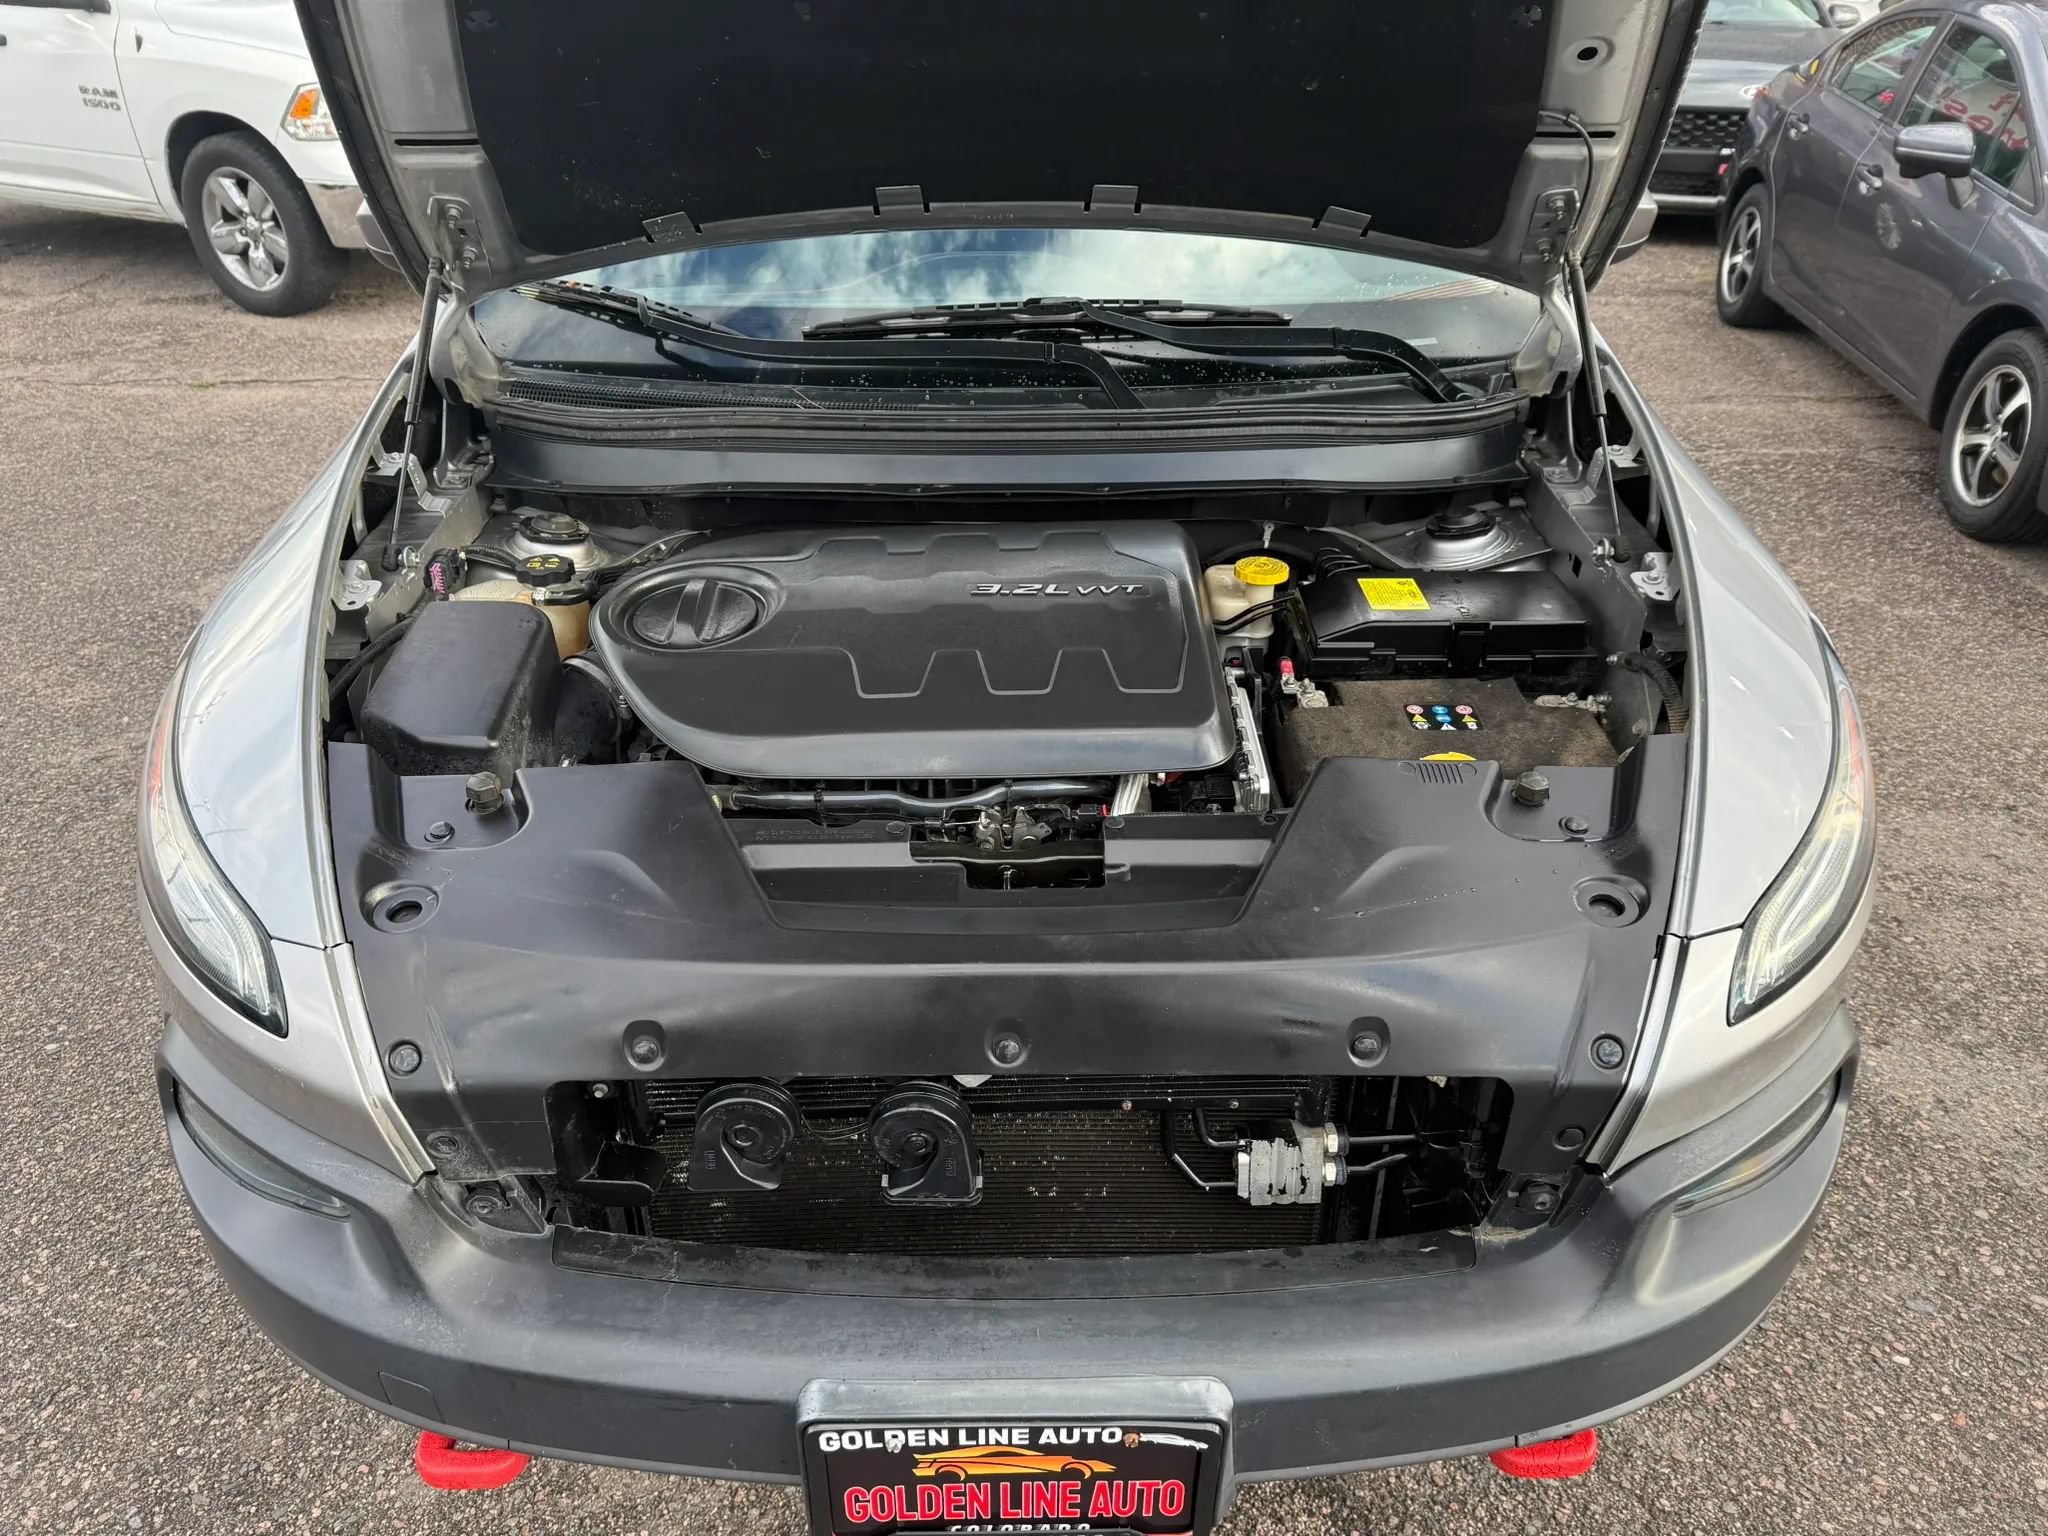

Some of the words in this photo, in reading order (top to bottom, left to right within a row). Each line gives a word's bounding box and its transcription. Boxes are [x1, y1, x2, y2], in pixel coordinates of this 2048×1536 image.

[78, 85, 118, 99] RAM
[82, 97, 122, 111] 1500
[970, 583, 1070, 596] 3.2L
[1076, 584, 1144, 596] VVT
[818, 1428, 949, 1452] GOLDEN
[958, 1428, 1030, 1446] LINE
[1038, 1427, 1123, 1445] AUTO
[844, 1482, 991, 1523] GOLDEN
[1000, 1480, 1081, 1520] LINE
[1088, 1479, 1186, 1518] AUTO
